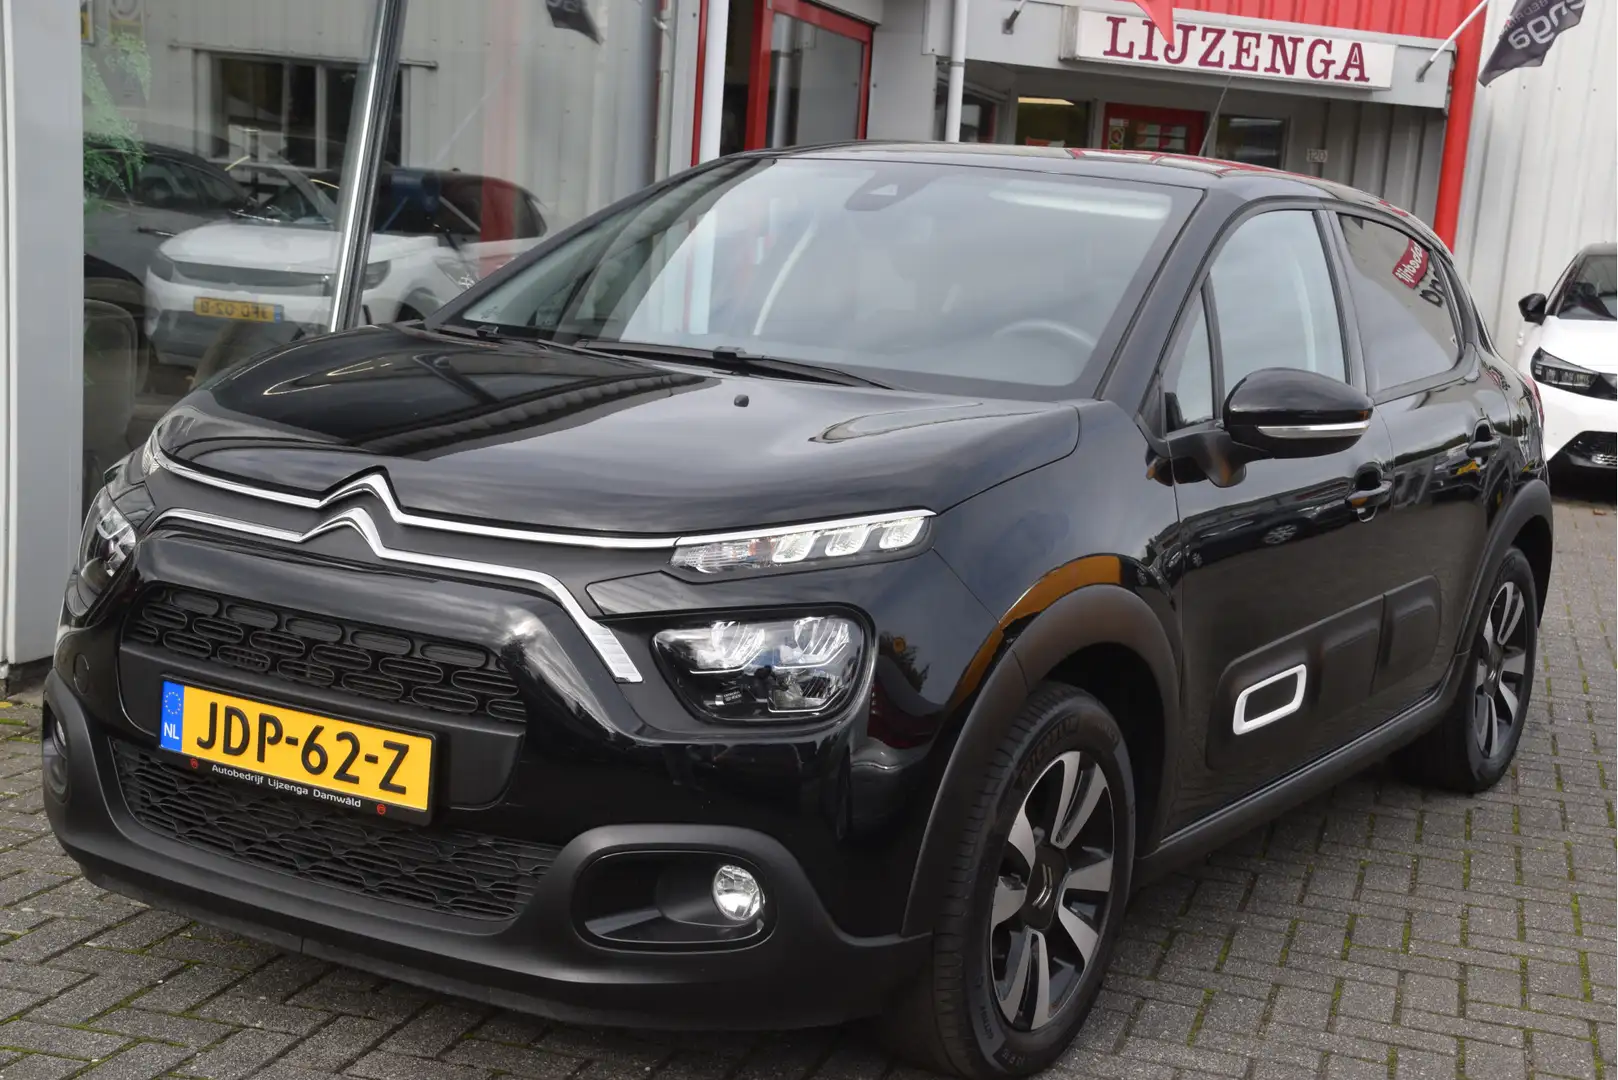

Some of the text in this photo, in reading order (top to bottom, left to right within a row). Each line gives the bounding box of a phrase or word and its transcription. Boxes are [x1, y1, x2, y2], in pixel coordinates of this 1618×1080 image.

[1103, 16, 1369, 82] LIJZENGA
[1309, 150, 1326, 162] 120
[164, 722, 180, 740] NL
[197, 701, 409, 795] JDP-62-Z
[212, 764, 264, 785] Autobedrijf
[268, 778, 309, 795] Lijzenga
